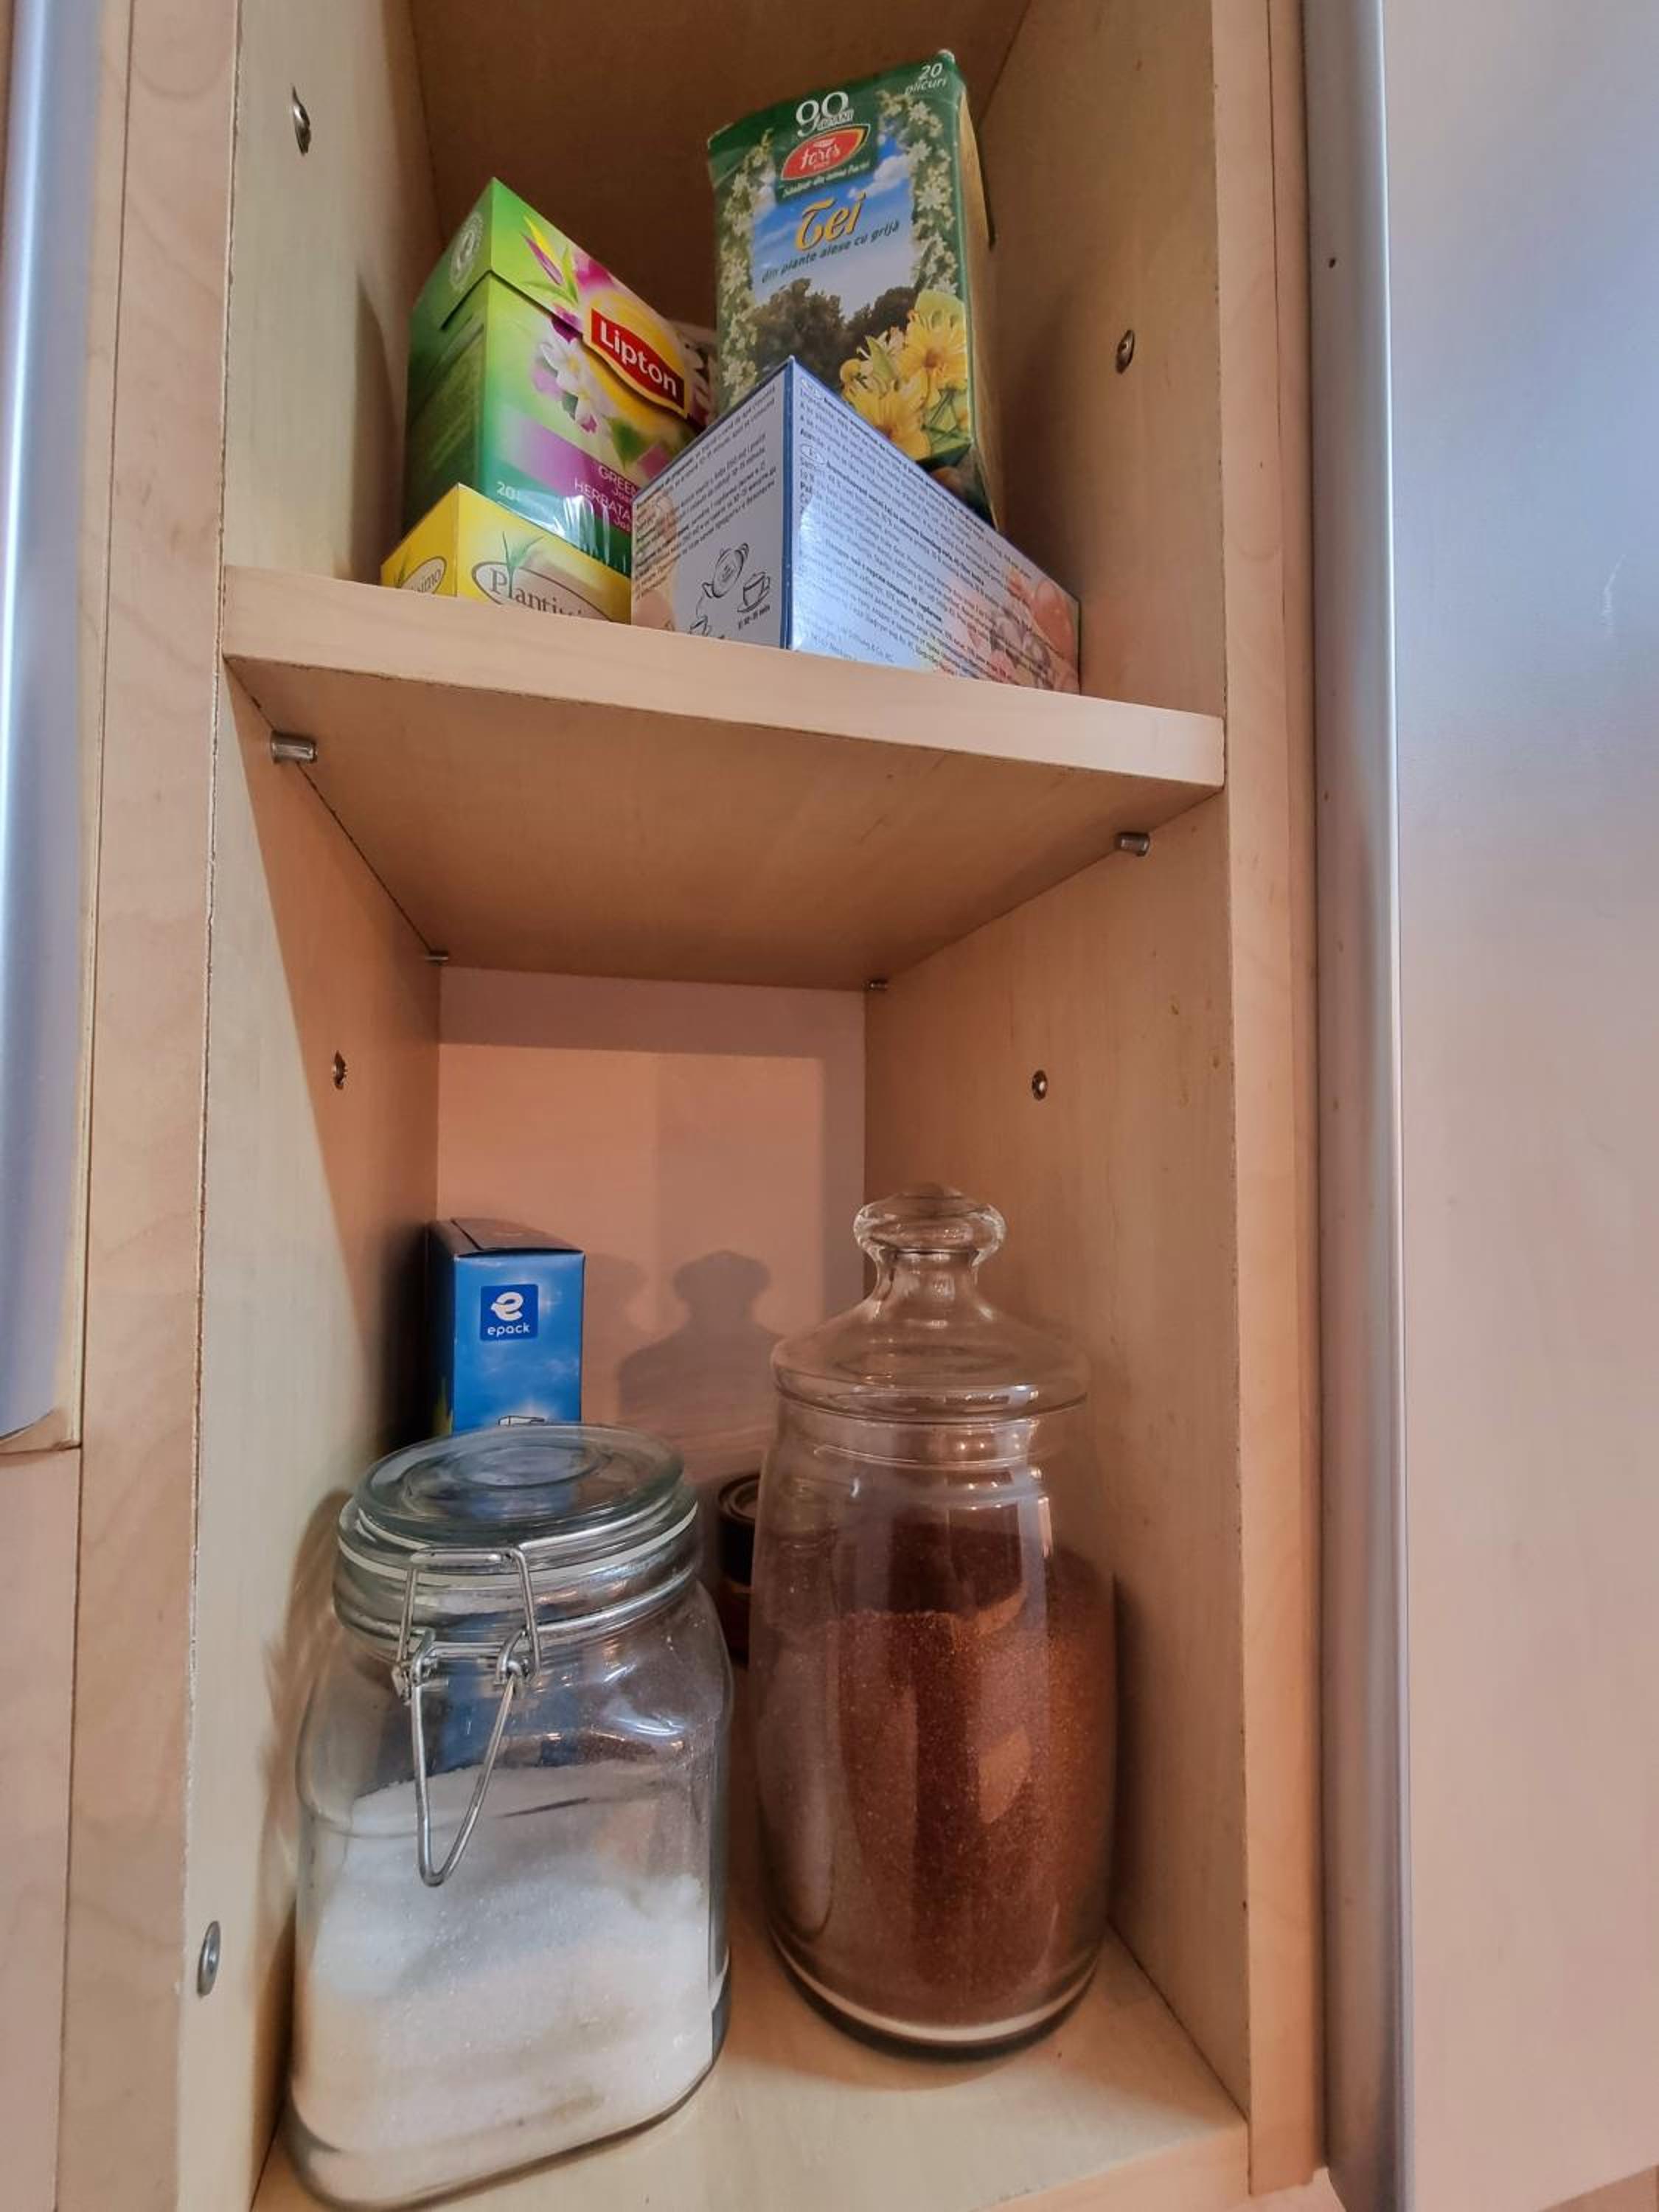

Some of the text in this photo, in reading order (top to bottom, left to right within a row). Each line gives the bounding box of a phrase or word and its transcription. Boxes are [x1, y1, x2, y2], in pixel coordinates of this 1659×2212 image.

[918, 62, 943, 80] 20
[796, 91, 849, 136] 90
[795, 192, 866, 251] Tei
[762, 267, 779, 283] din
[781, 251, 817, 274] plante
[820, 240, 852, 258] alese
[854, 234, 869, 246] cu
[600, 320, 678, 397] Lipton
[574, 478, 630, 520] HERBATA
[487, 1323, 530, 1338] epack
